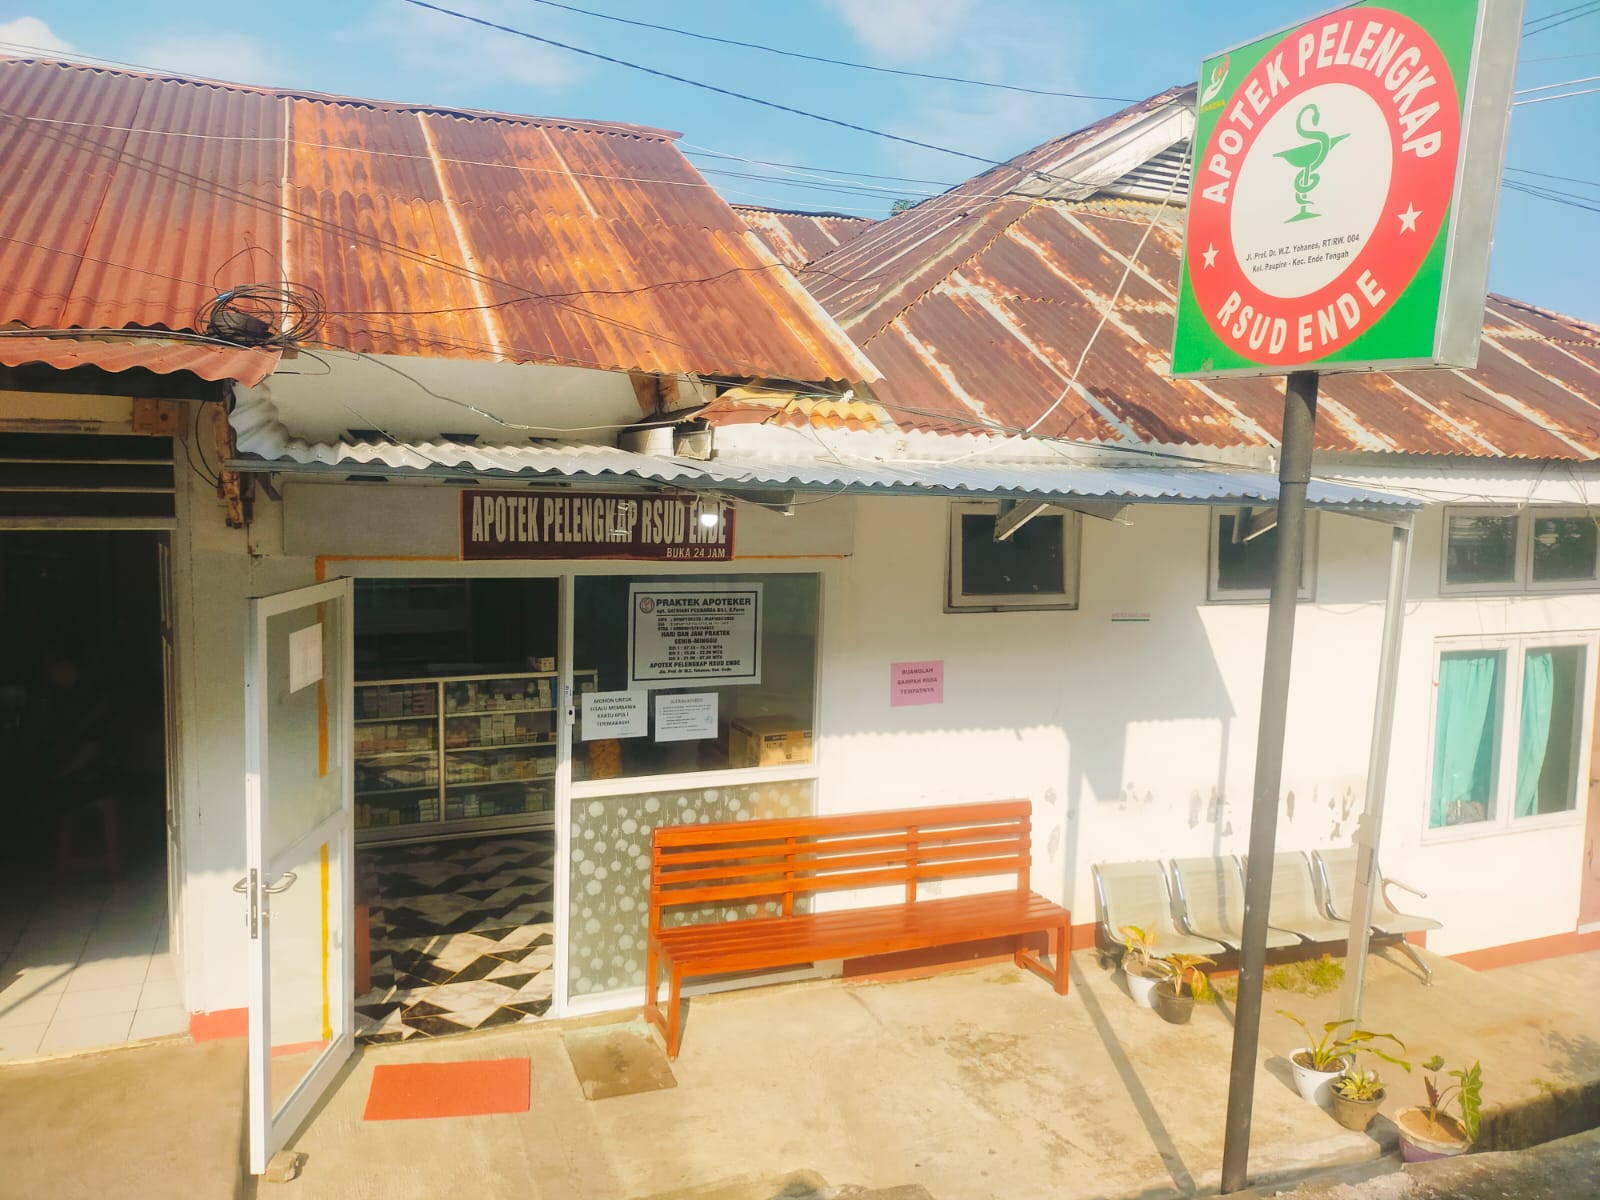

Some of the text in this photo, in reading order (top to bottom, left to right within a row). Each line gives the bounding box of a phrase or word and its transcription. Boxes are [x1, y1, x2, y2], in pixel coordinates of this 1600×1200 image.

[1202, 20, 1442, 204] APOTEK PELENGKAP
[1278, 246, 1291, 256] W.Z.
[1292, 258, 1306, 266] Kec.
[1308, 255, 1324, 264] Ende
[1216, 268, 1387, 355] RSUD ENDE
[472, 496, 540, 542] APOTEK
[544, 497, 638, 544] PELENGKAP
[642, 499, 685, 544] RSUD
[666, 548, 726, 558] BUKA 24 JAM
